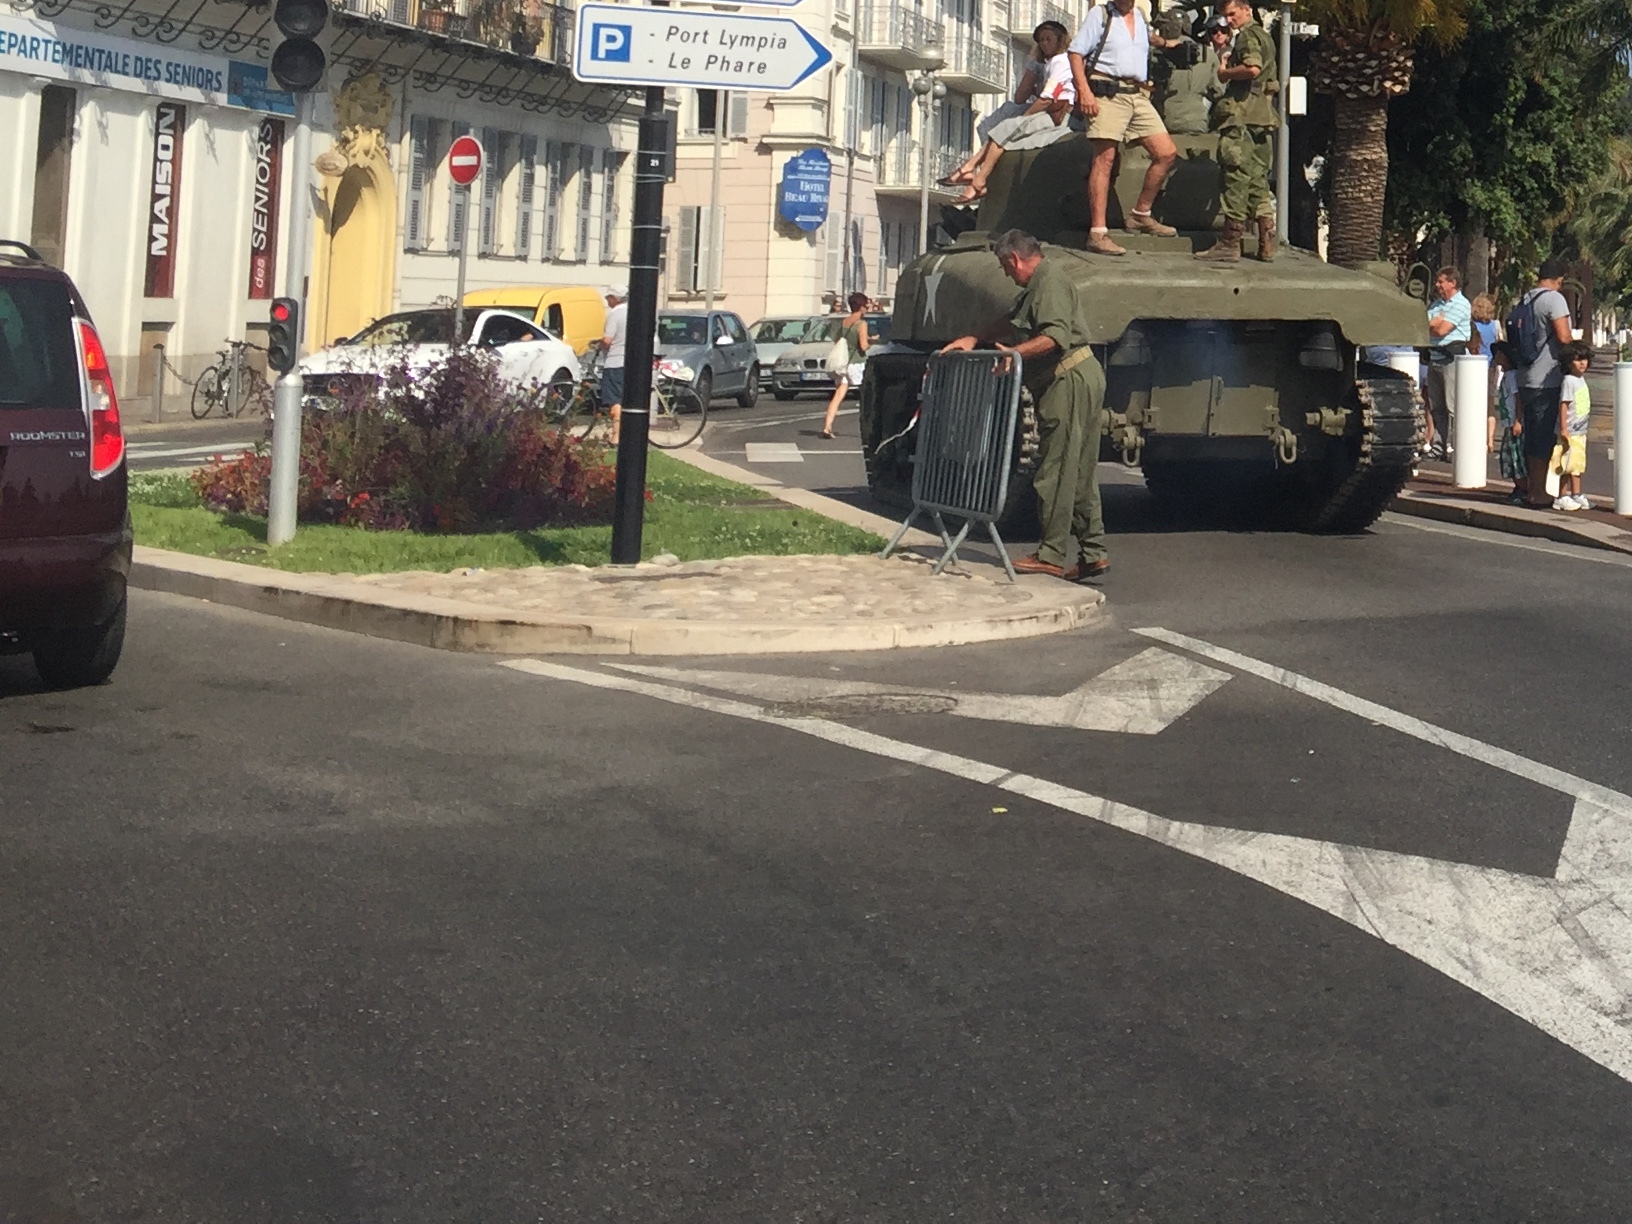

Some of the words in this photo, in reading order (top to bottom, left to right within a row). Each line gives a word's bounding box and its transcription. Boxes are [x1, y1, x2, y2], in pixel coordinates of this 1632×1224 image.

[665, 25, 710, 45] Port
[719, 29, 787, 52] Lympia
[133, 54, 162, 81] DES
[165, 62, 223, 93] SENIORS
[668, 54, 692, 71] Le
[706, 55, 767, 75] Phare
[151, 107, 175, 257] MAISON
[252, 121, 273, 251] SENIORS
[254, 258, 265, 289] des
[10, 431, 85, 440] ROOMSTER
